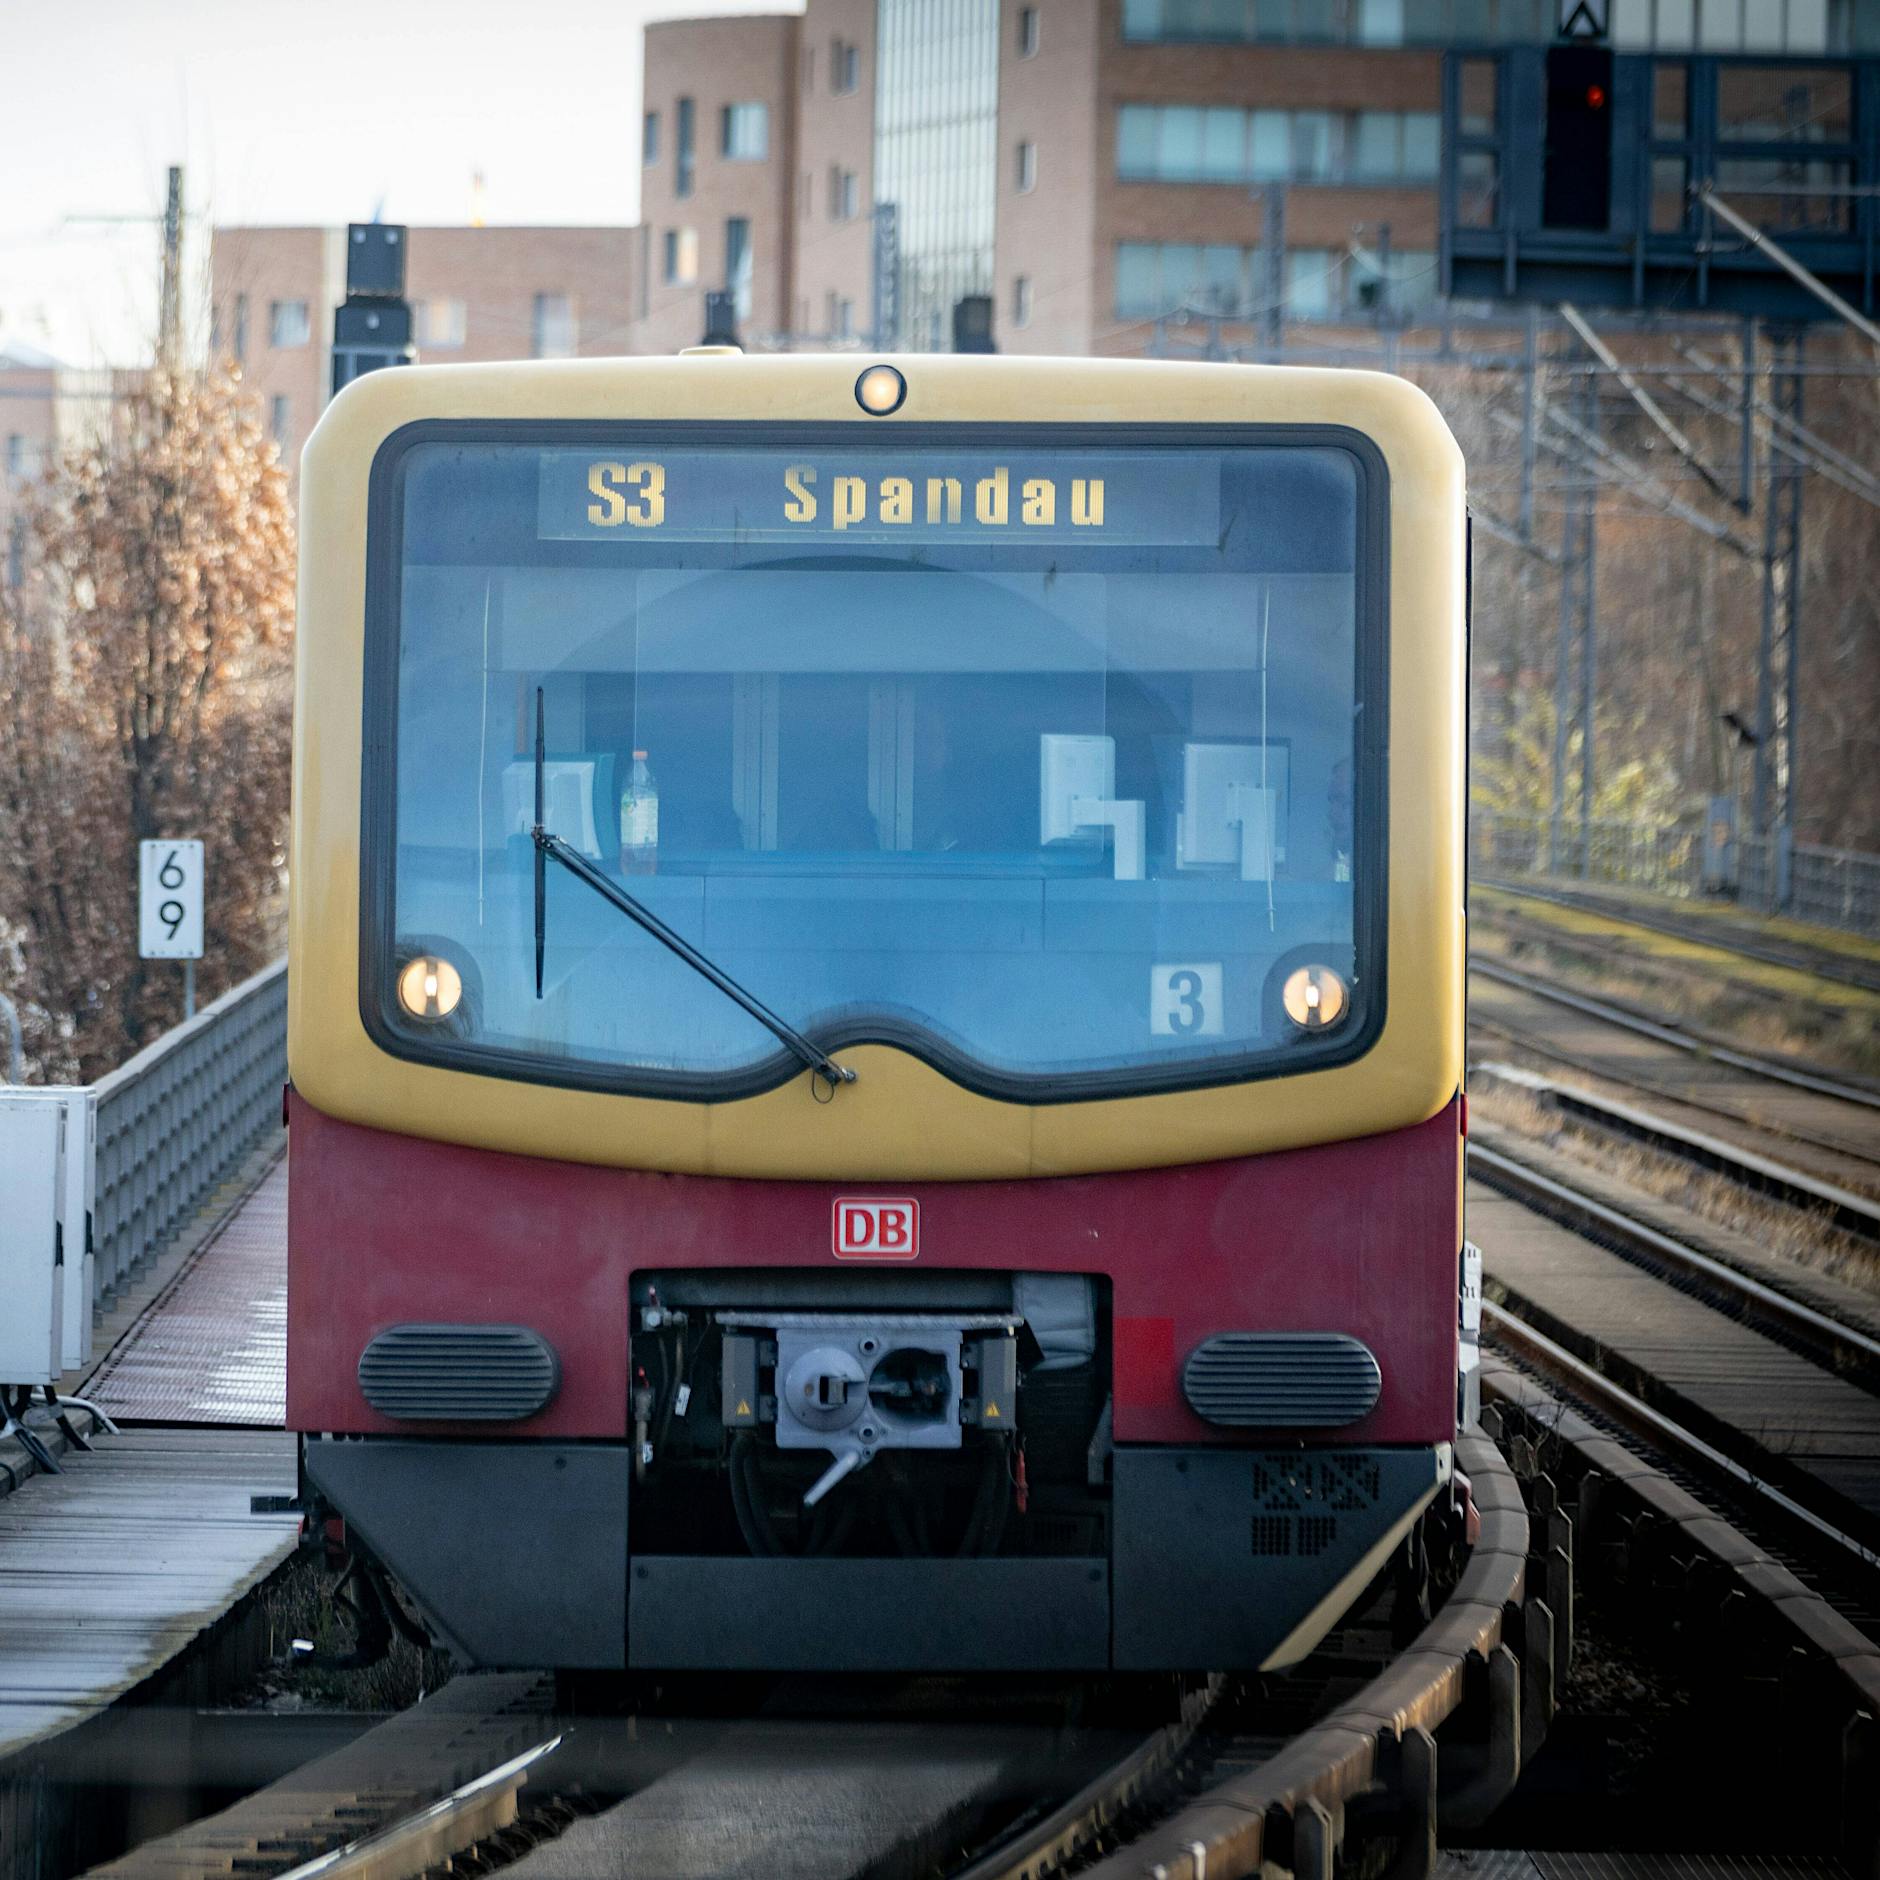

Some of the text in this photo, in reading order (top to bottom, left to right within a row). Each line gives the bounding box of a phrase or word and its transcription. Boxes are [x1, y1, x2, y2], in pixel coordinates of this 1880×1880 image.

[588, 462, 1104, 530] S3 Spandau
[160, 850, 184, 890] 6
[160, 901, 184, 940] 9
[1168, 971, 1205, 1035] 3
[845, 1209, 908, 1248] DB
